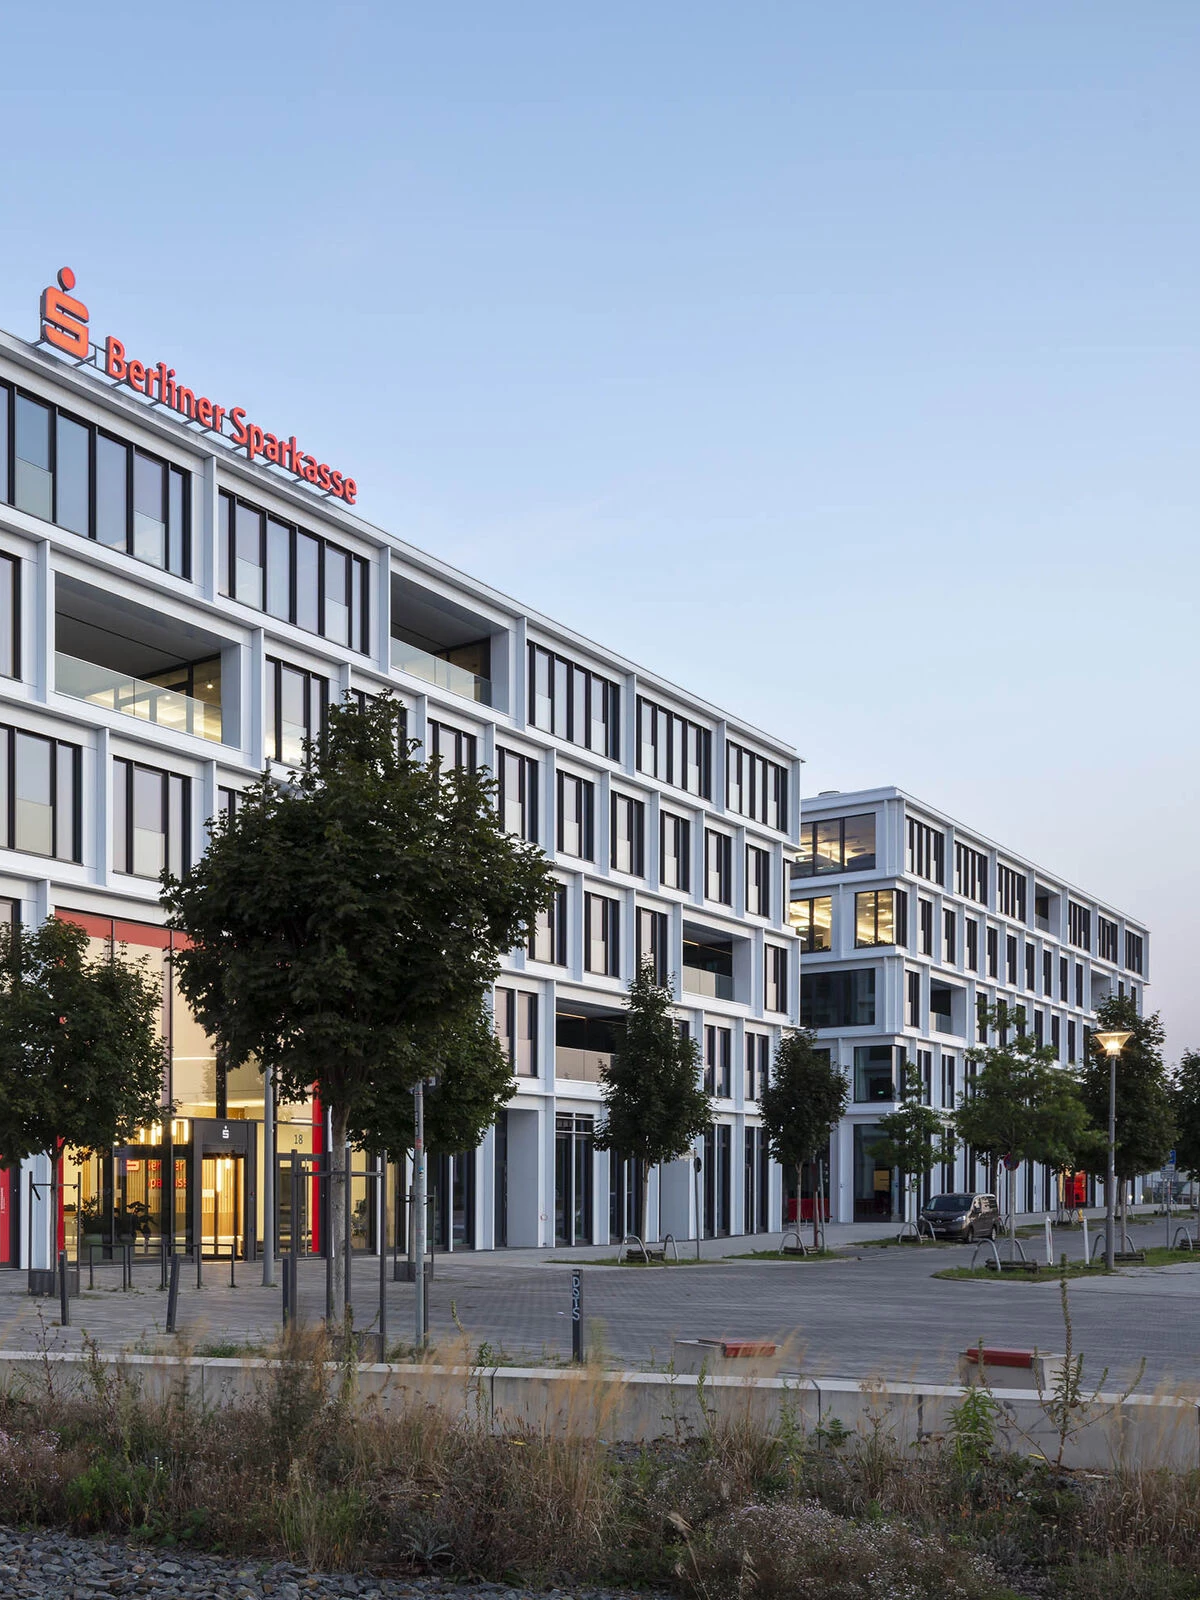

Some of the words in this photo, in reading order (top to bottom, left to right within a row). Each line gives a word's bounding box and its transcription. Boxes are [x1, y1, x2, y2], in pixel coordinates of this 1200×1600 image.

[105, 335, 227, 432] Berliner
[230, 406, 358, 505] Sparkasse
[294, 1134, 304, 1145] 18
